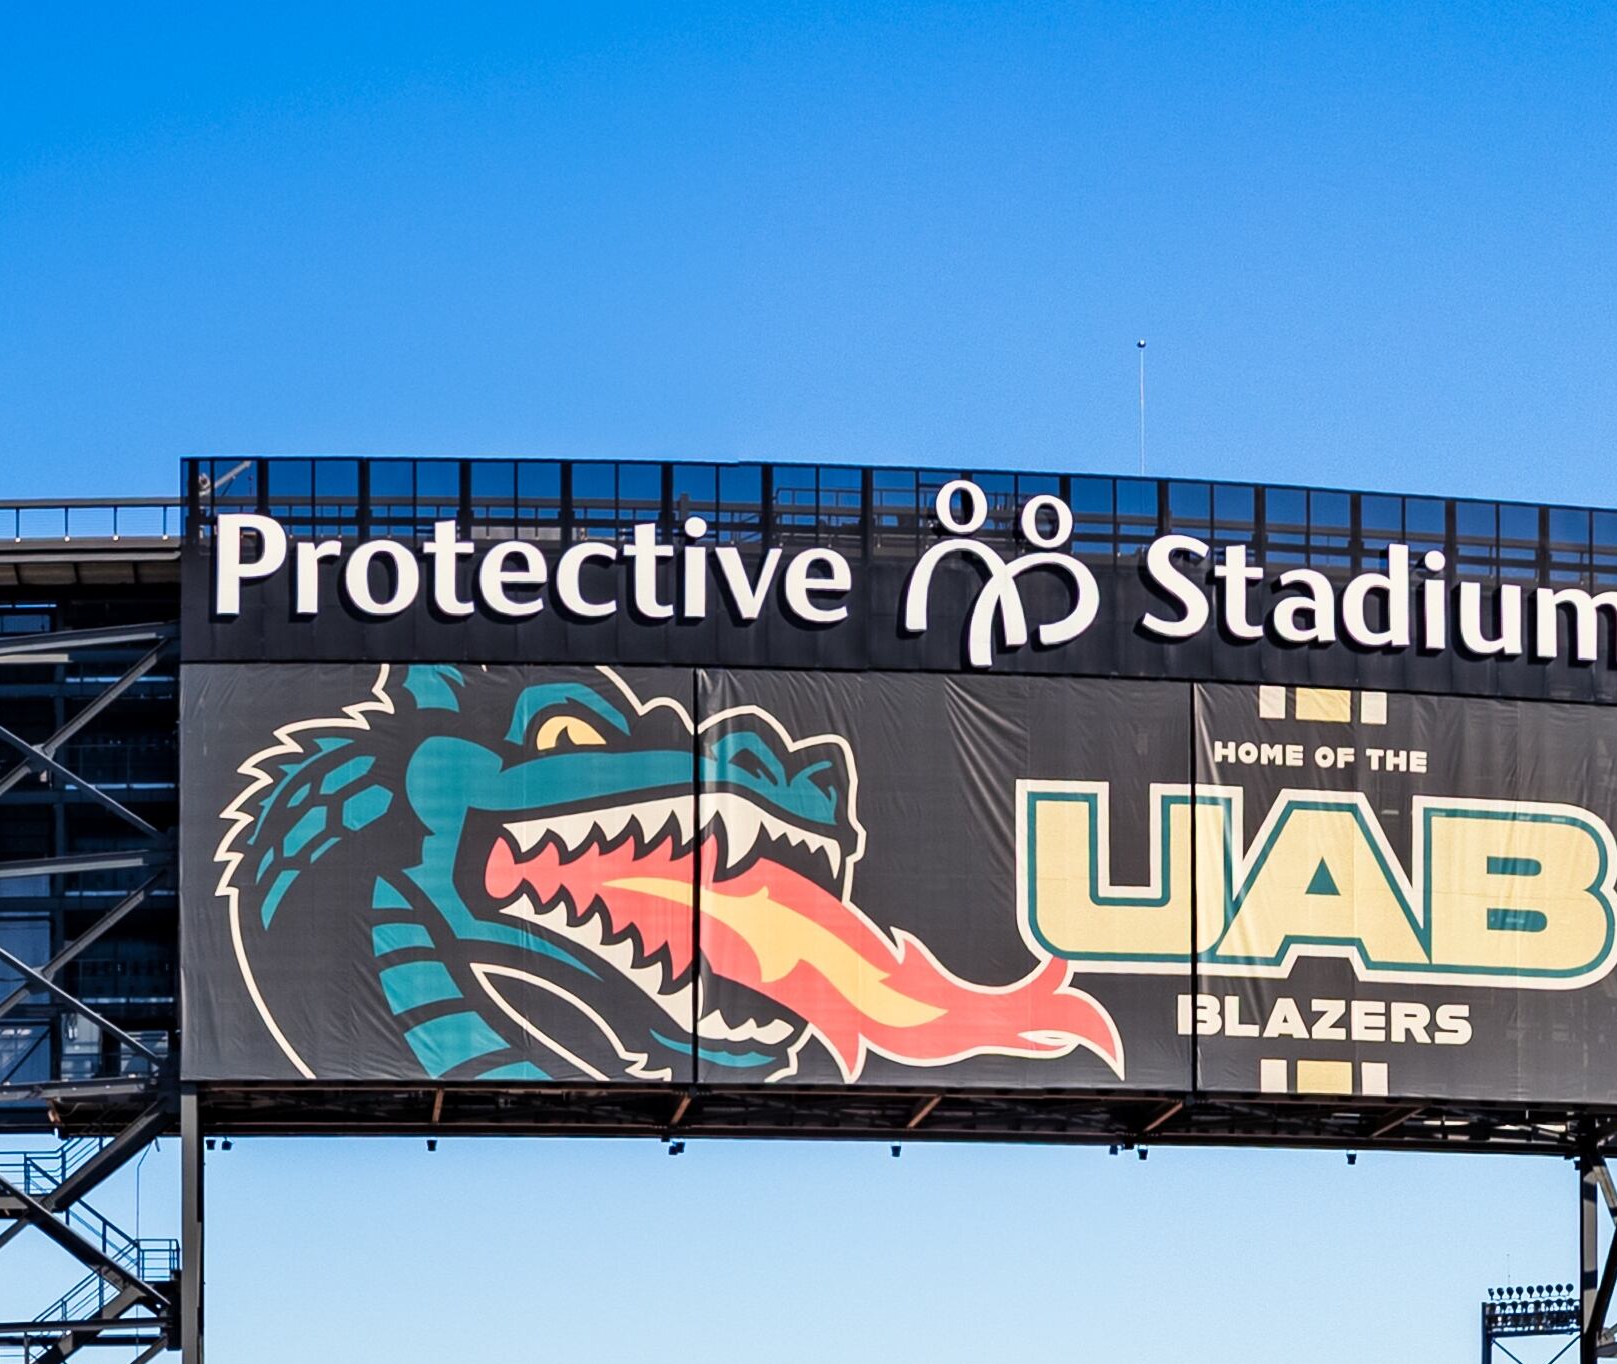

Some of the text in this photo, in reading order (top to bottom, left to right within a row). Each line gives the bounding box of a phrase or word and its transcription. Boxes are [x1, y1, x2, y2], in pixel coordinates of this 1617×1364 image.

[215, 512, 852, 622] Protective
[1213, 740, 1428, 774] HOME OF THE
[1177, 993, 1473, 1046] BLAZERS
